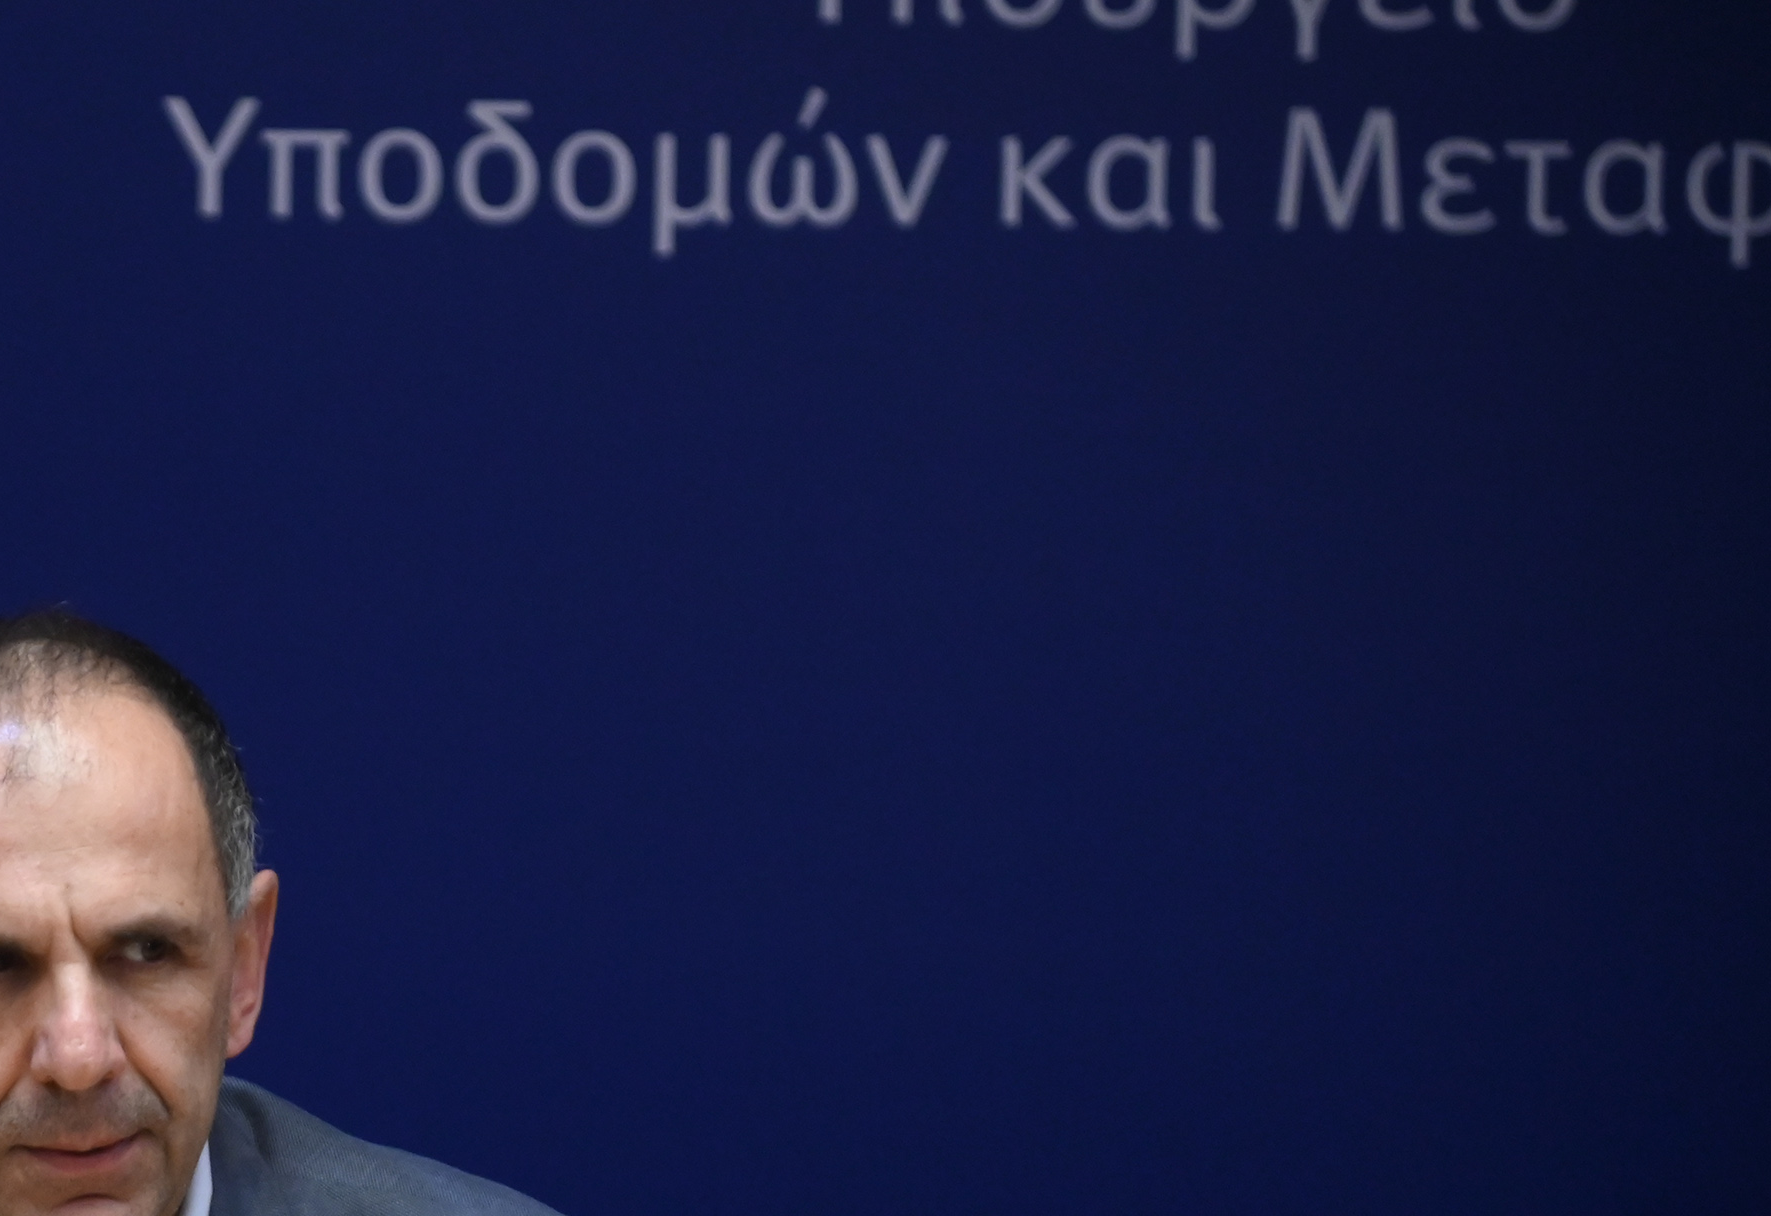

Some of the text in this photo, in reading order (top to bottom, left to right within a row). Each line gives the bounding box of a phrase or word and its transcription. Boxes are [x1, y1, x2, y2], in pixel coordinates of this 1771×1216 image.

[162, 86, 1771, 269] Υποδομών και Μεταφ
